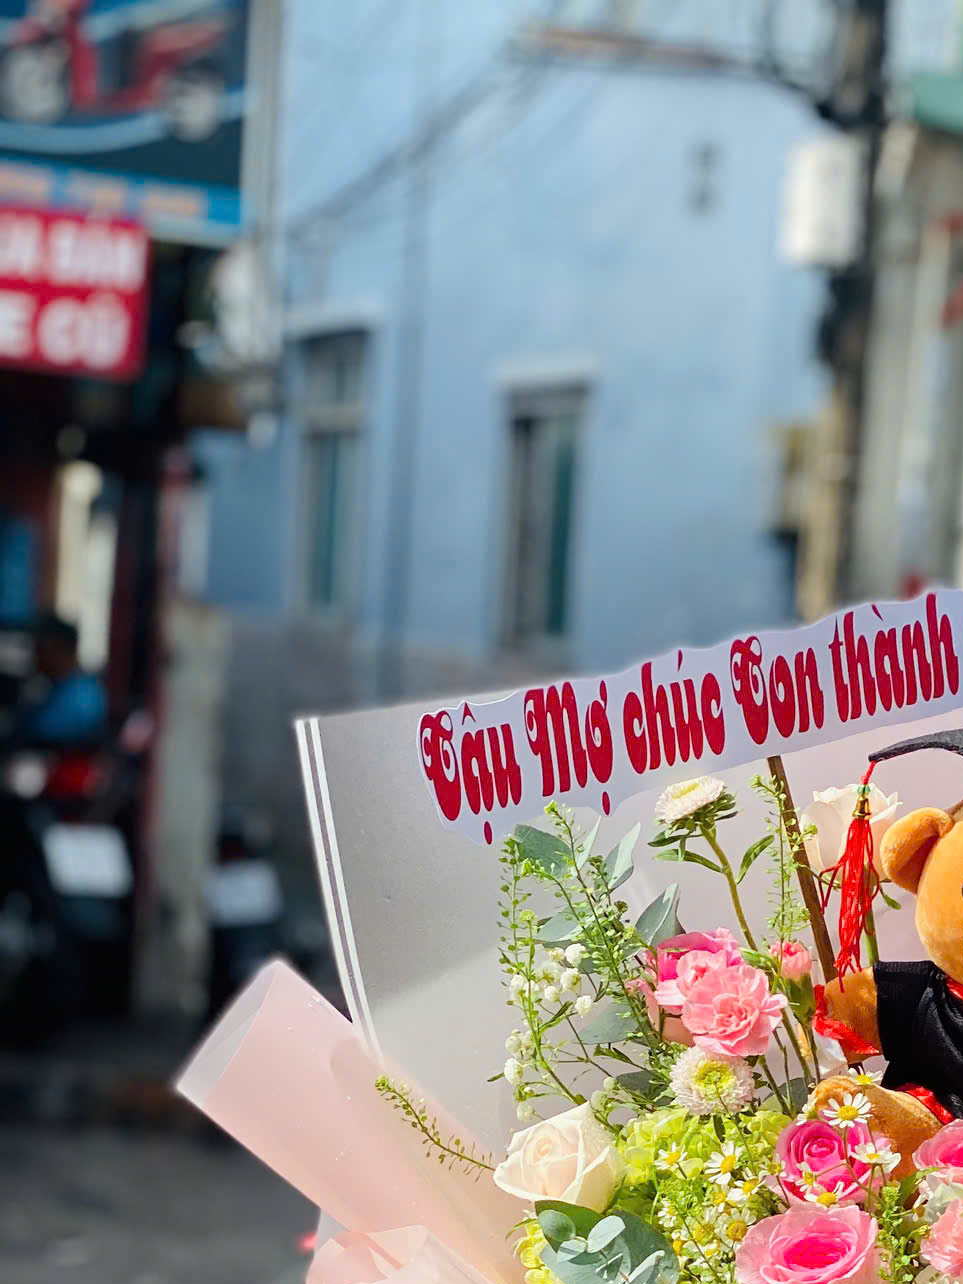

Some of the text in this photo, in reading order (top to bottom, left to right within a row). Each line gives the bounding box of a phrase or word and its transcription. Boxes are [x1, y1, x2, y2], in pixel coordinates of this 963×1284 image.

[421, 702, 522, 845] Cậu
[523, 680, 614, 816] Mợ
[622, 650, 727, 774] chúc
[729, 635, 825, 746] Con
[828, 592, 961, 722] thành
